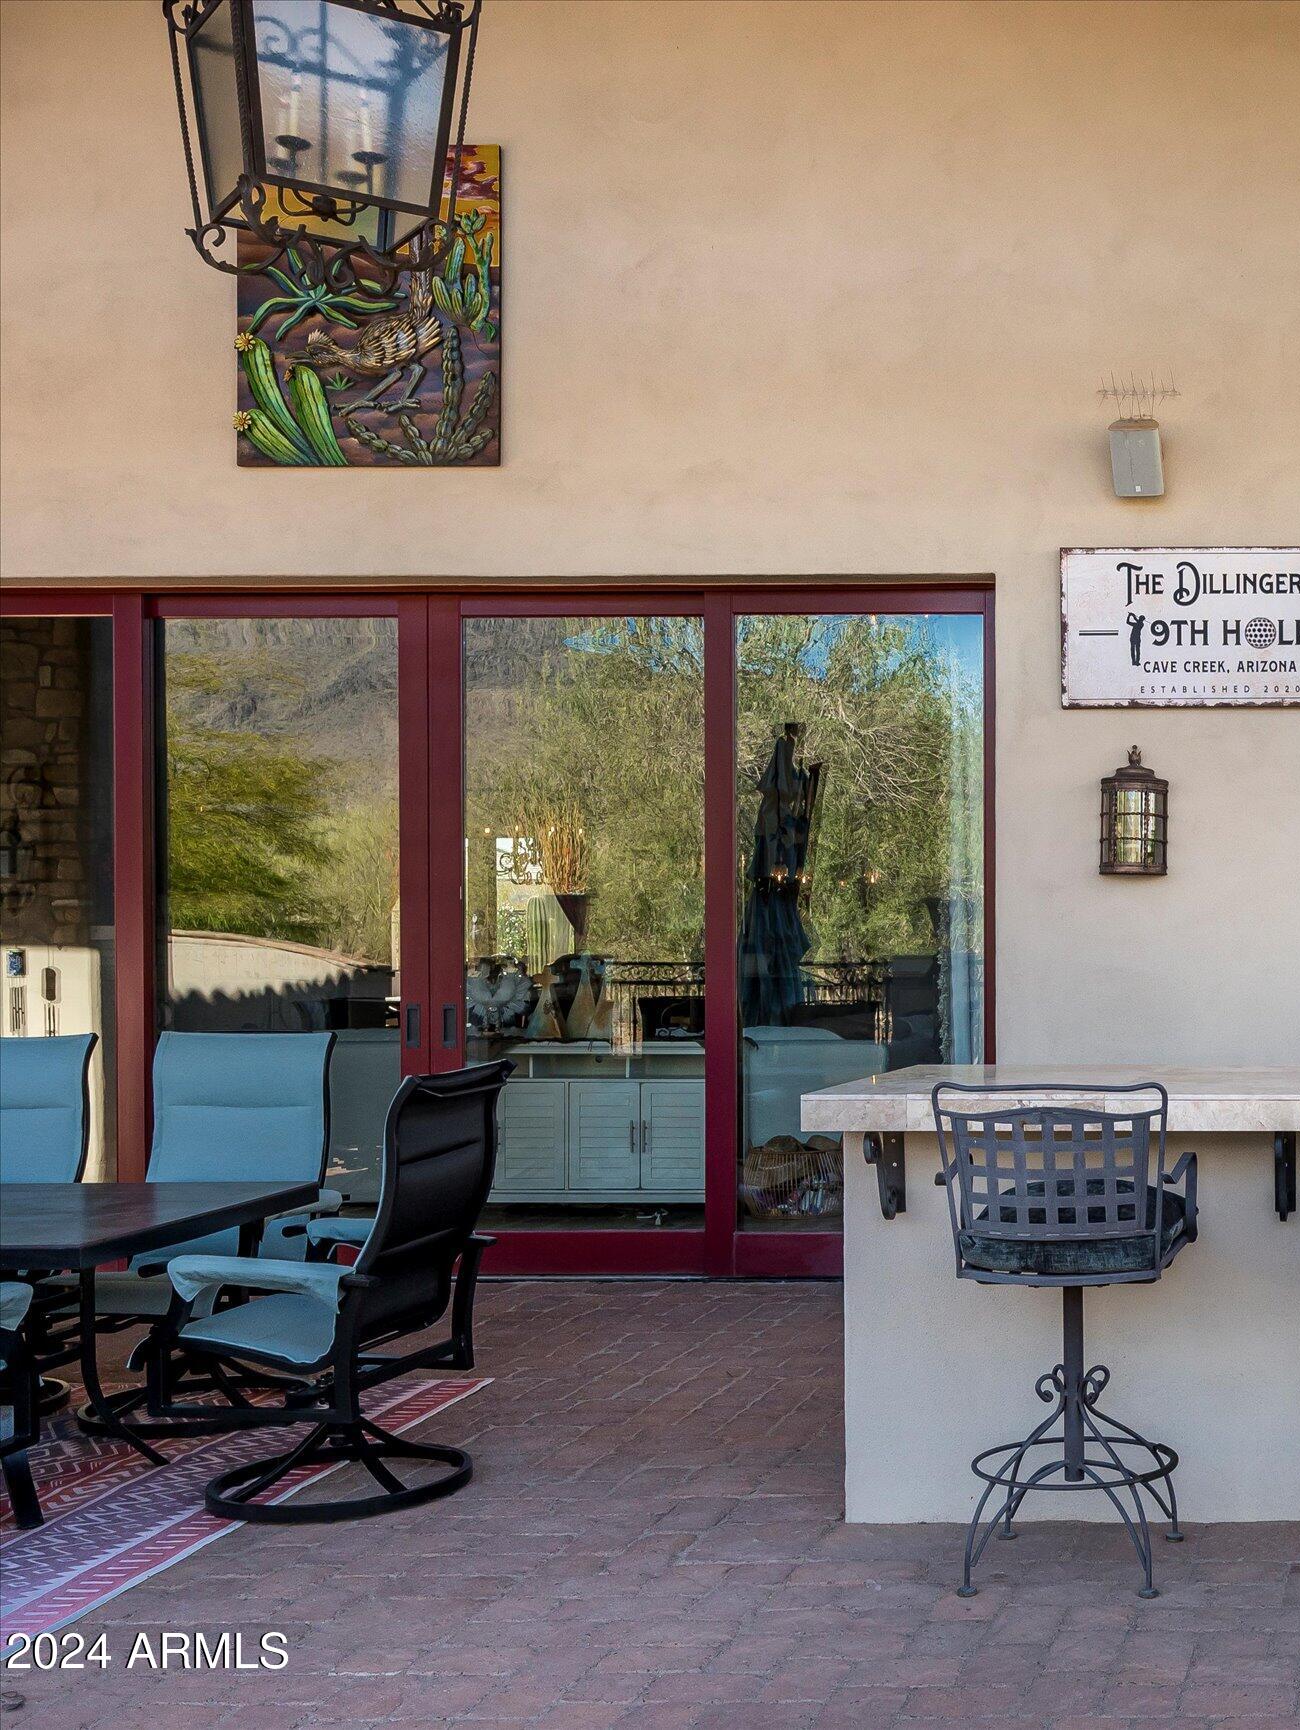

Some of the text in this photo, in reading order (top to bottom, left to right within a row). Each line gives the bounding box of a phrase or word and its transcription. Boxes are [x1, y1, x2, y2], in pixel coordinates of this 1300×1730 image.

[1143, 660, 1297, 674] CAVE CREEK, ARIZONA
[1140, 684, 1300, 694] ESTABLISHED 2020
